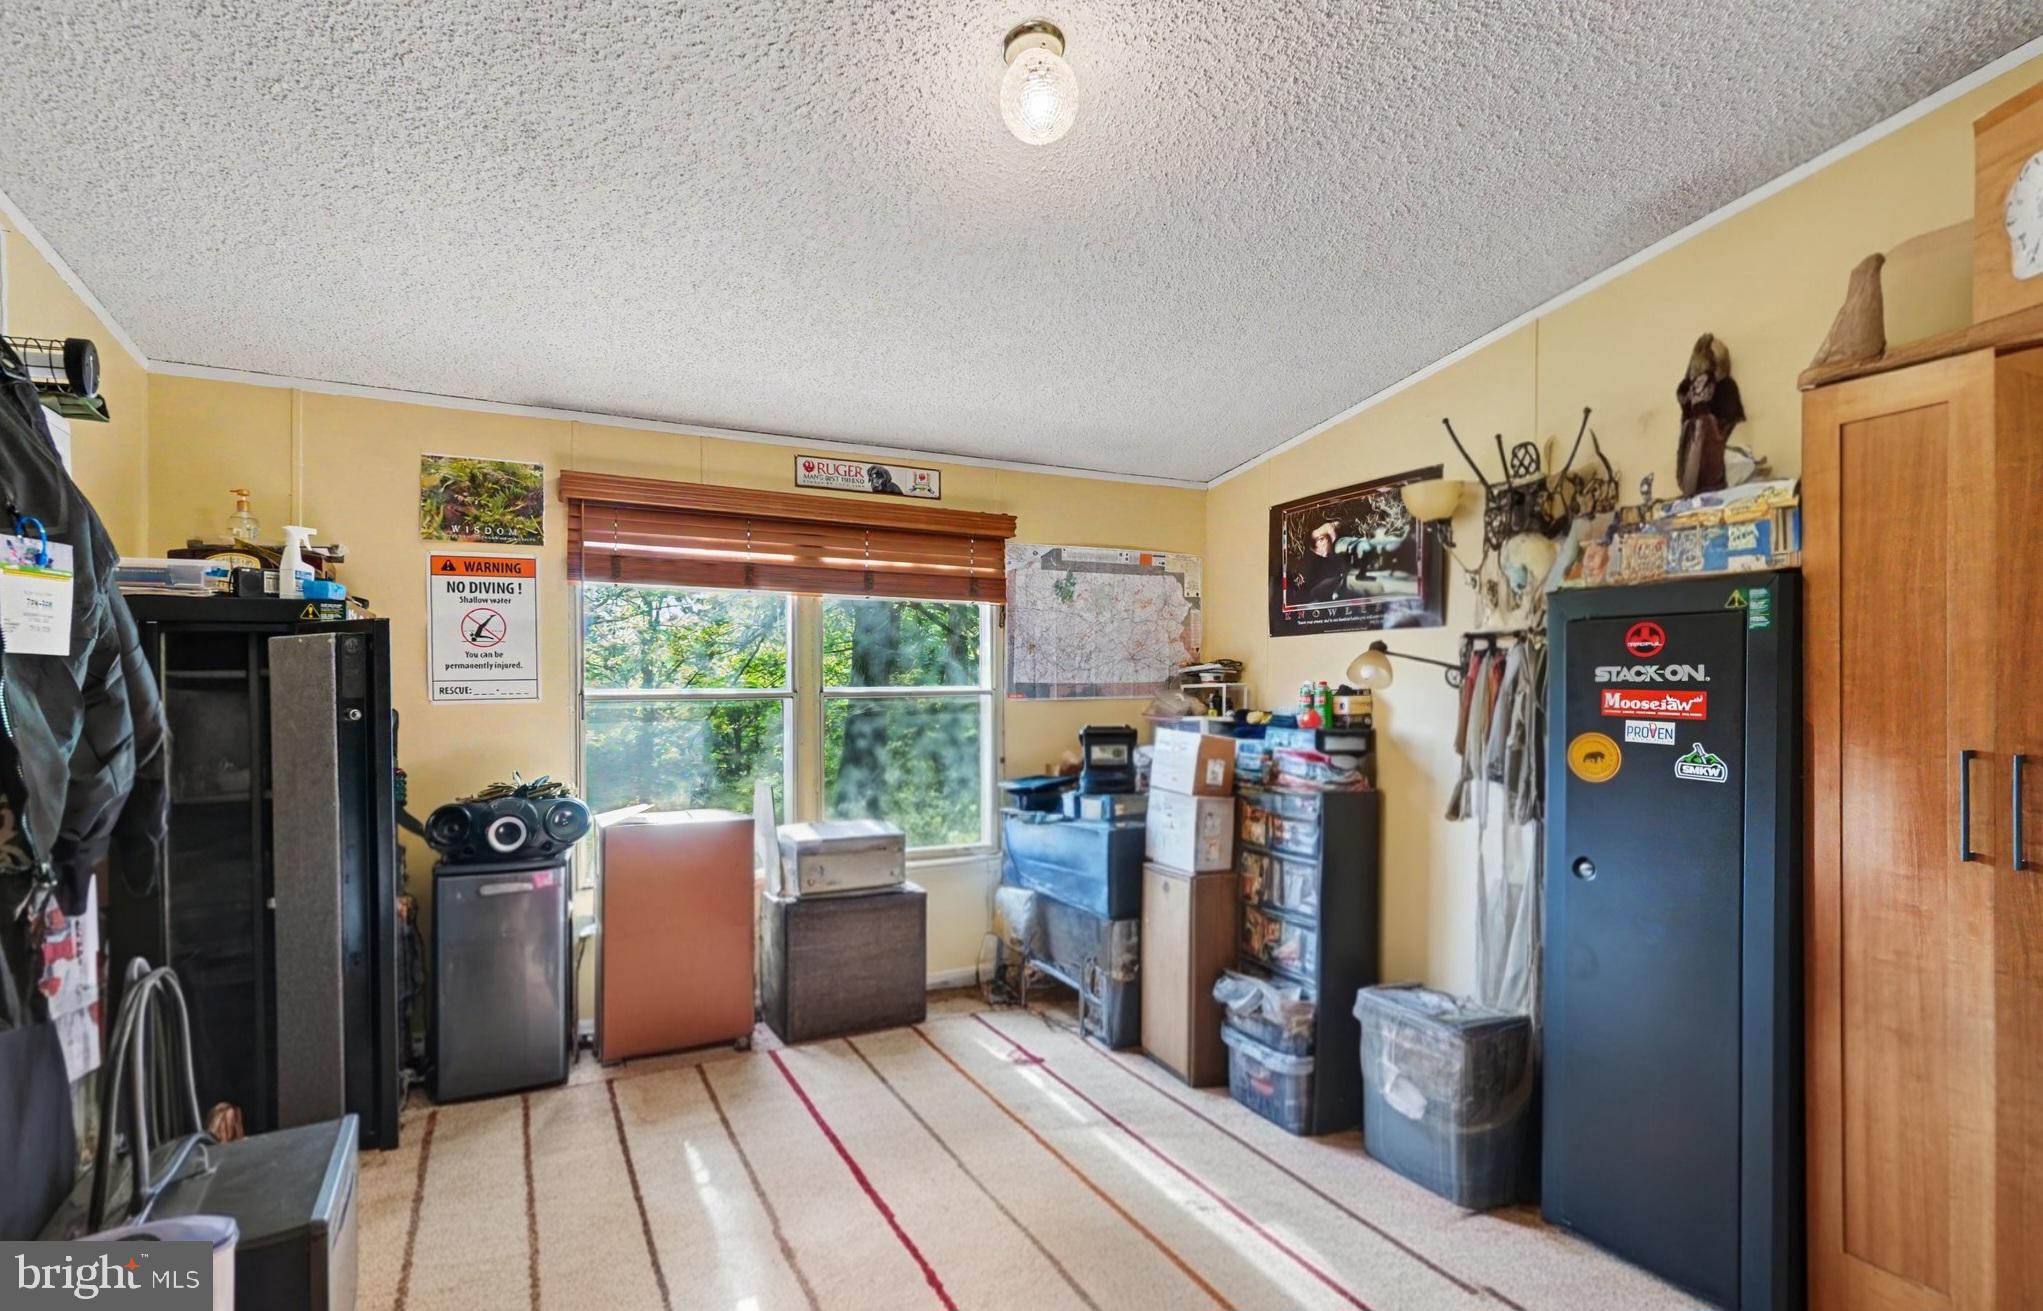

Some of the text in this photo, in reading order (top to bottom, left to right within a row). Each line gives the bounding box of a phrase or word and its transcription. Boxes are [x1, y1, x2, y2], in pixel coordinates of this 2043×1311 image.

[817, 462, 864, 478] RUGER
[451, 525, 518, 536] WISDOM
[463, 561, 522, 574] WARNING
[446, 581, 465, 593] NO
[469, 581, 514, 594] DIVING
[459, 595, 511, 605] Shallow water
[464, 650, 479, 658] You
[480, 651, 493, 659] can
[445, 662, 493, 671] permanently
[439, 686, 472, 695] RESCUE:
[1682, 765, 1721, 777] SMKW
